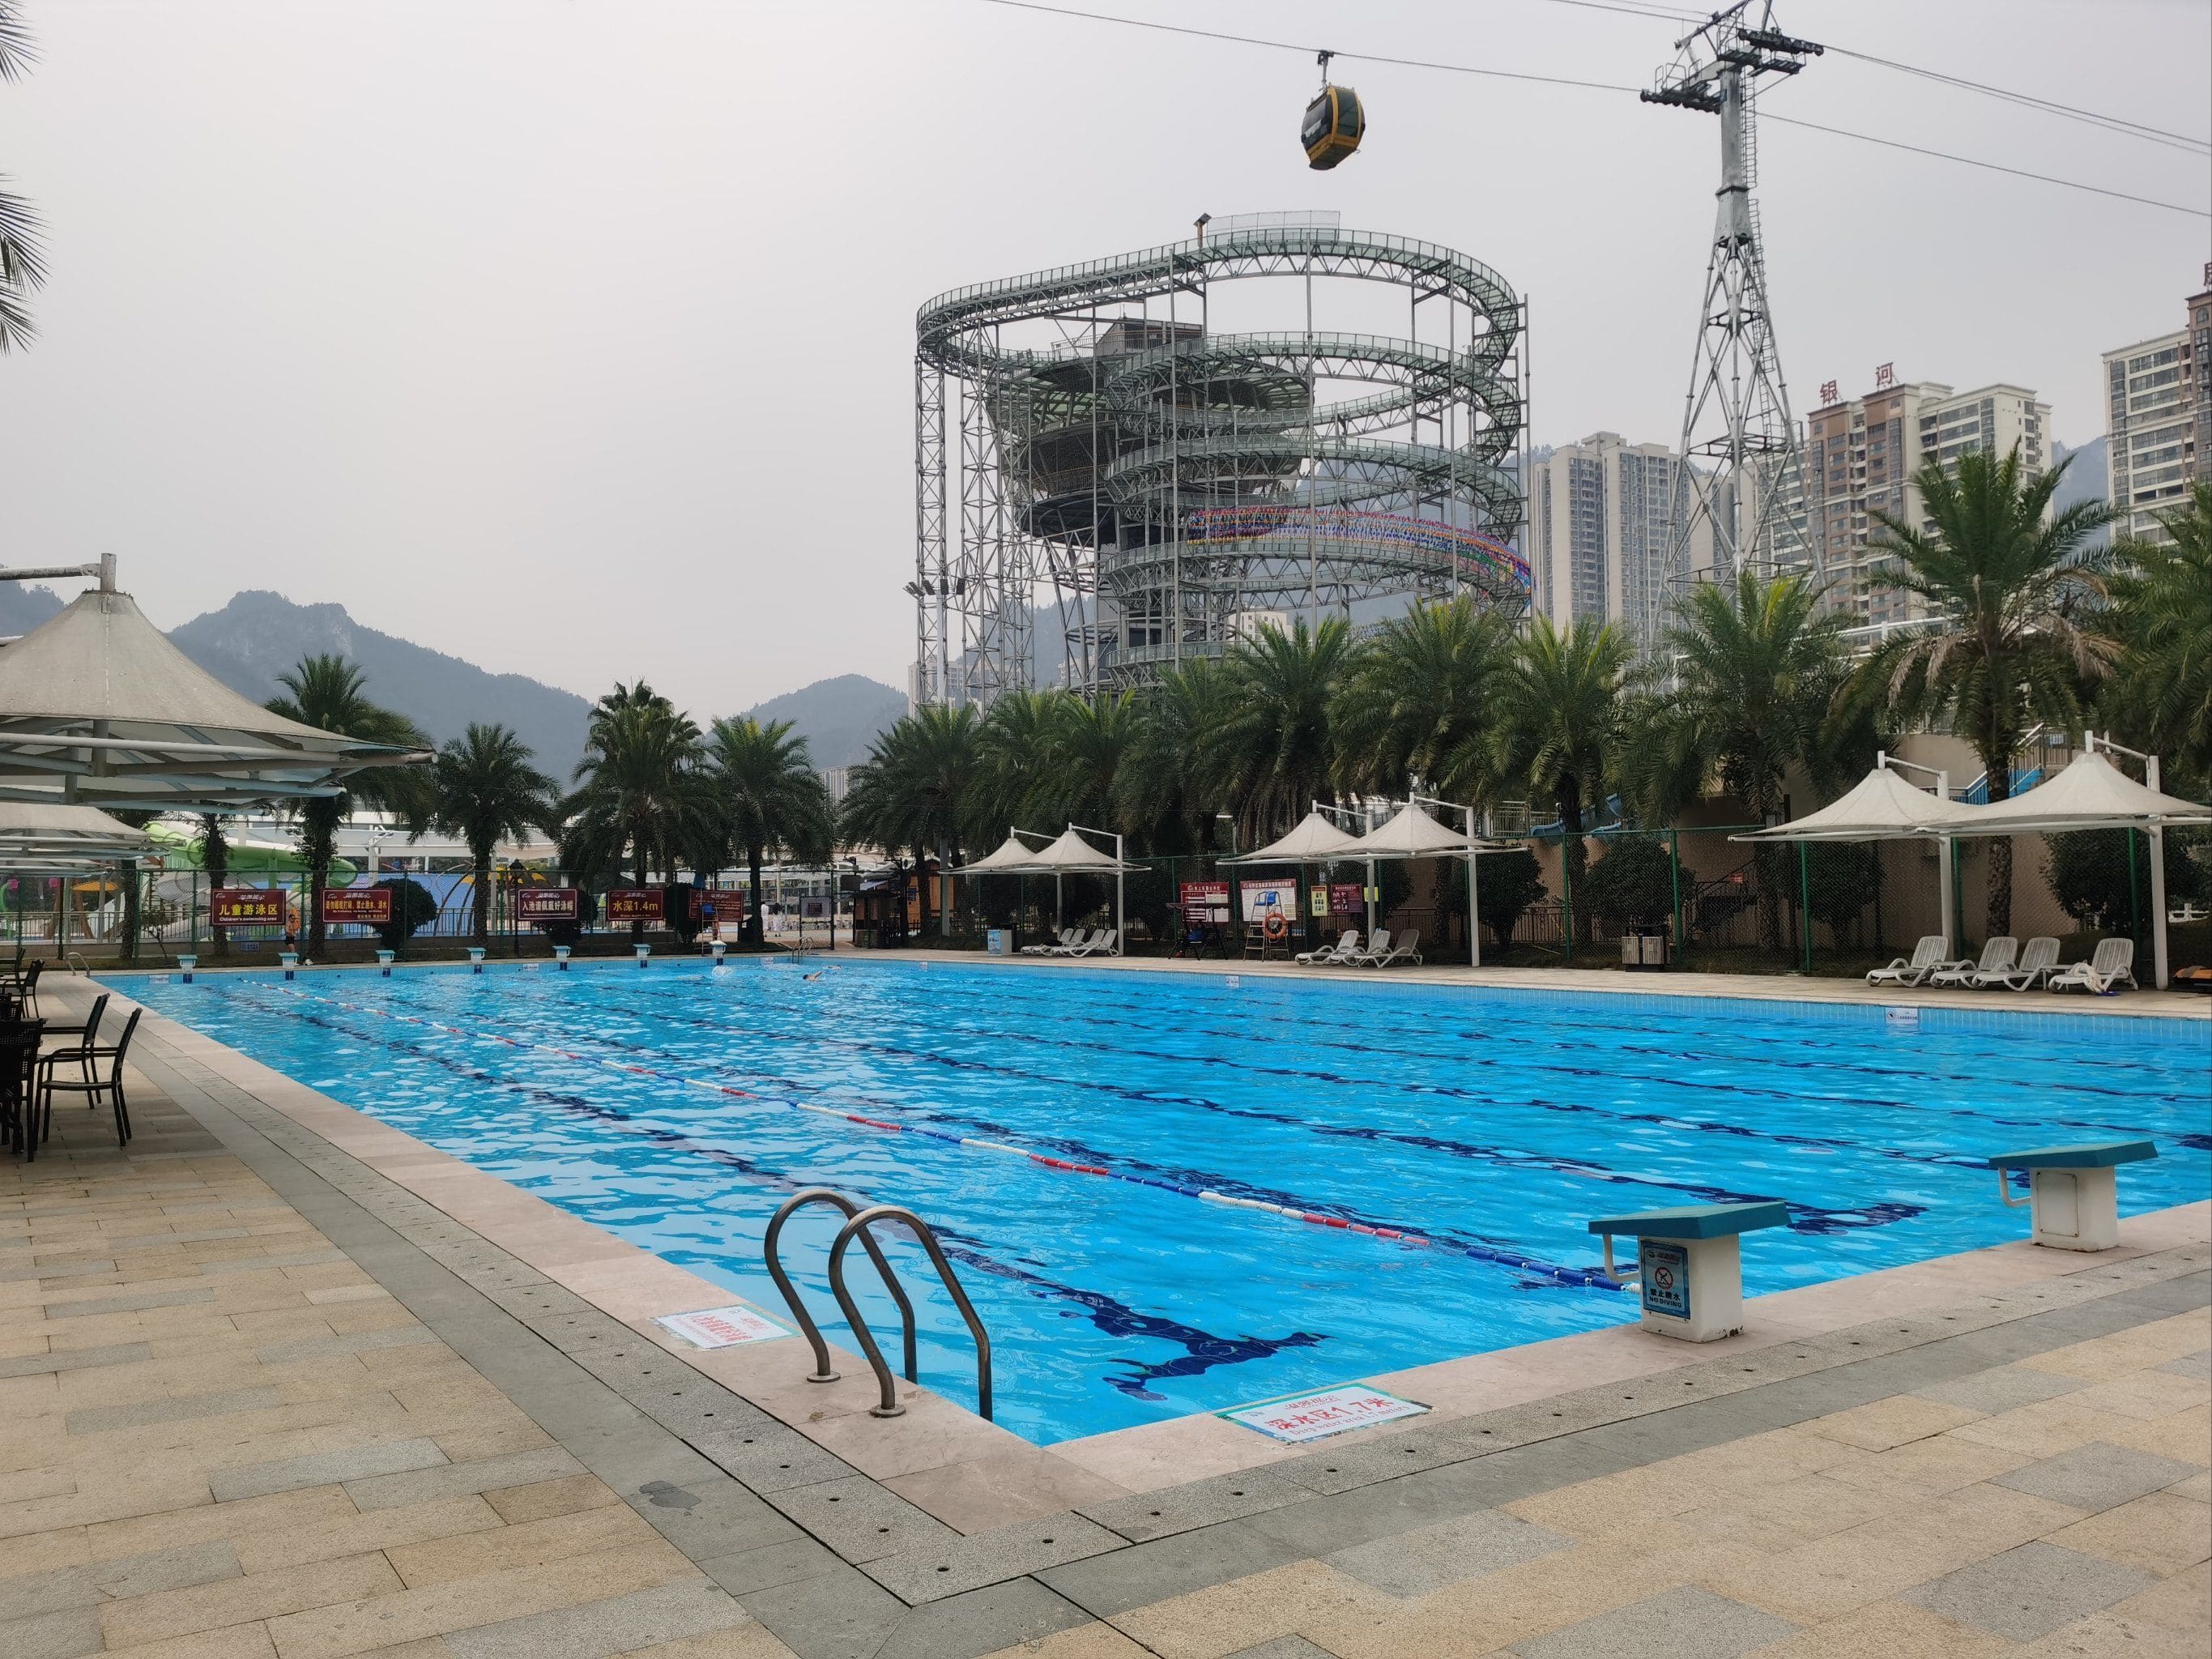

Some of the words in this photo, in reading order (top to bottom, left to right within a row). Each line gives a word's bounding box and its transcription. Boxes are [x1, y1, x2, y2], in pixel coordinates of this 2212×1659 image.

[219, 903, 278, 916] 儿童游泳区
[612, 900, 658, 912] 水深1.4m
[1659, 1298, 1682, 1308] DIVING
[1264, 1397, 1394, 1431] 深水区1.7米
